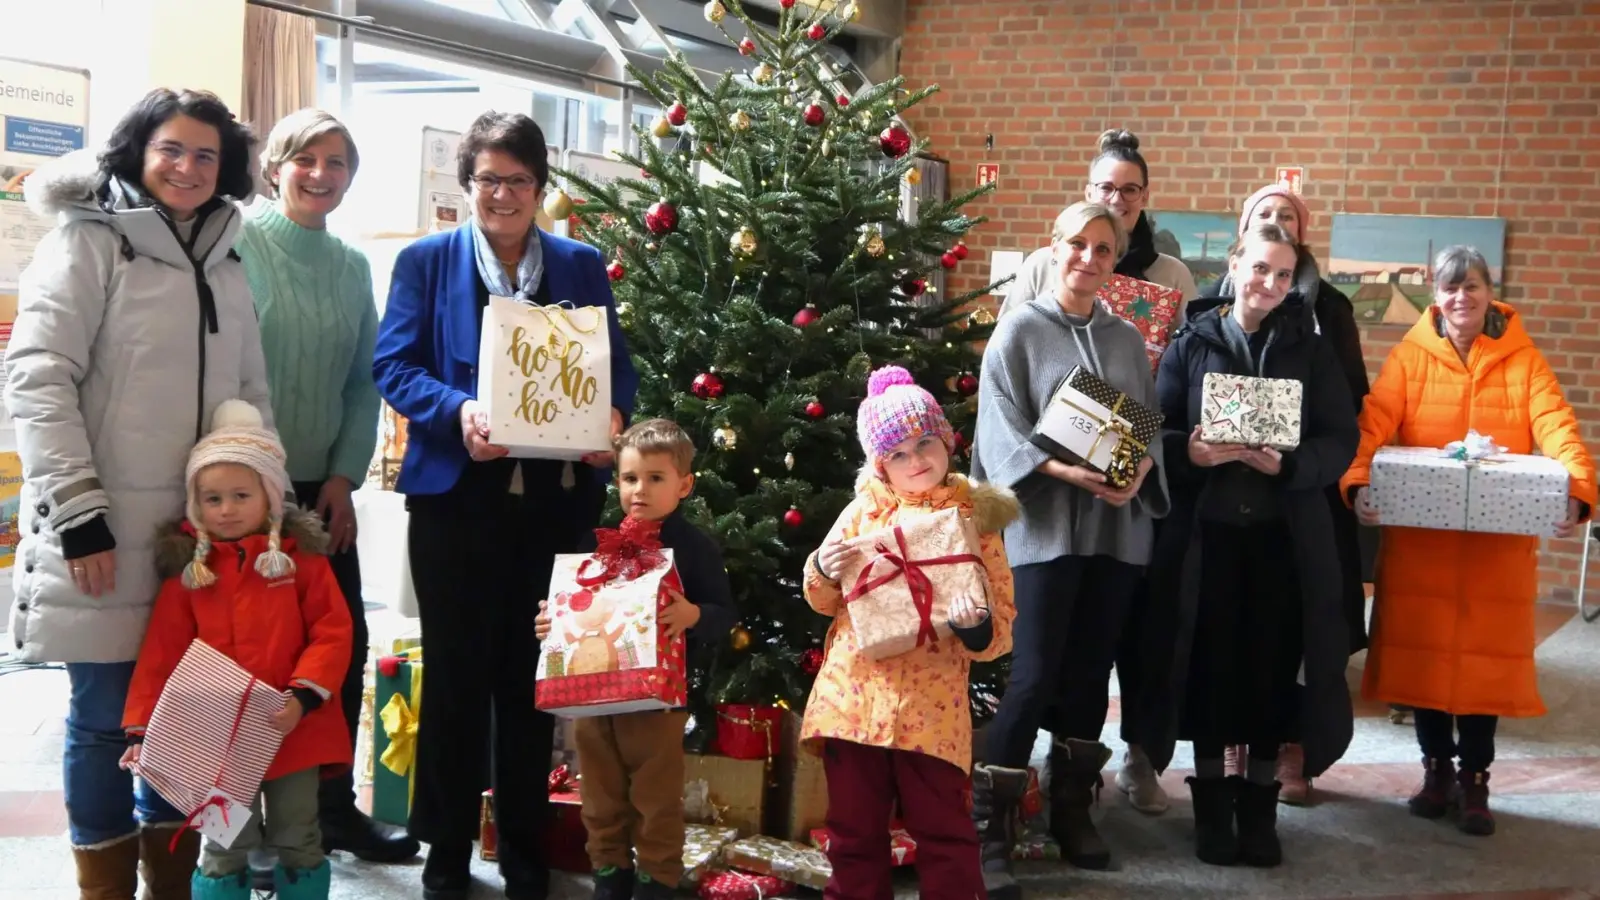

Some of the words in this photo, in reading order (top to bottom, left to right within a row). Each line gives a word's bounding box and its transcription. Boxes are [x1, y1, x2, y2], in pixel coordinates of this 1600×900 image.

[506, 326, 553, 378] ho
[550, 340, 599, 409] ho
[514, 380, 563, 426] ho
[1069, 415, 1093, 435] 133
